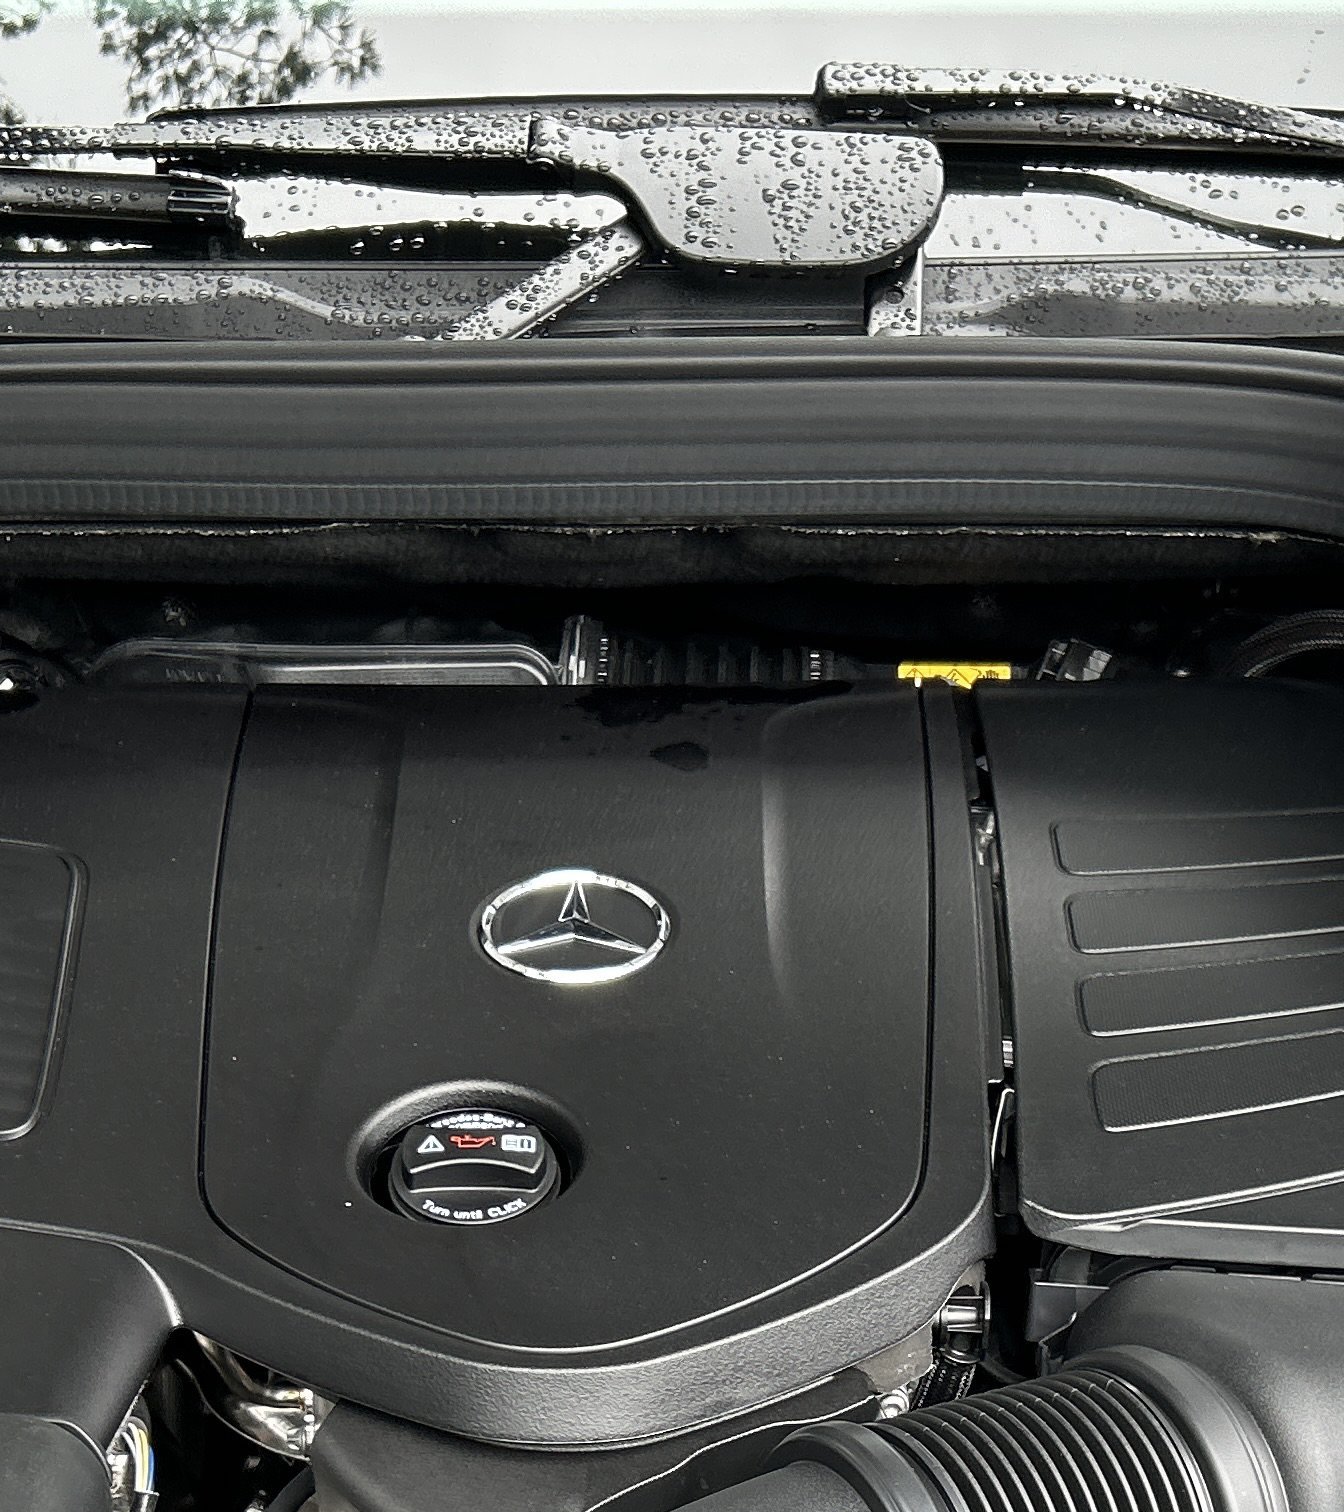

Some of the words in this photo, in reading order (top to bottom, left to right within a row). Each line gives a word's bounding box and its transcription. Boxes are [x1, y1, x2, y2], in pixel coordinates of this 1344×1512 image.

[422, 1199, 451, 1217] Turn
[453, 1209, 483, 1220] until
[487, 1198, 527, 1218] CLICK
